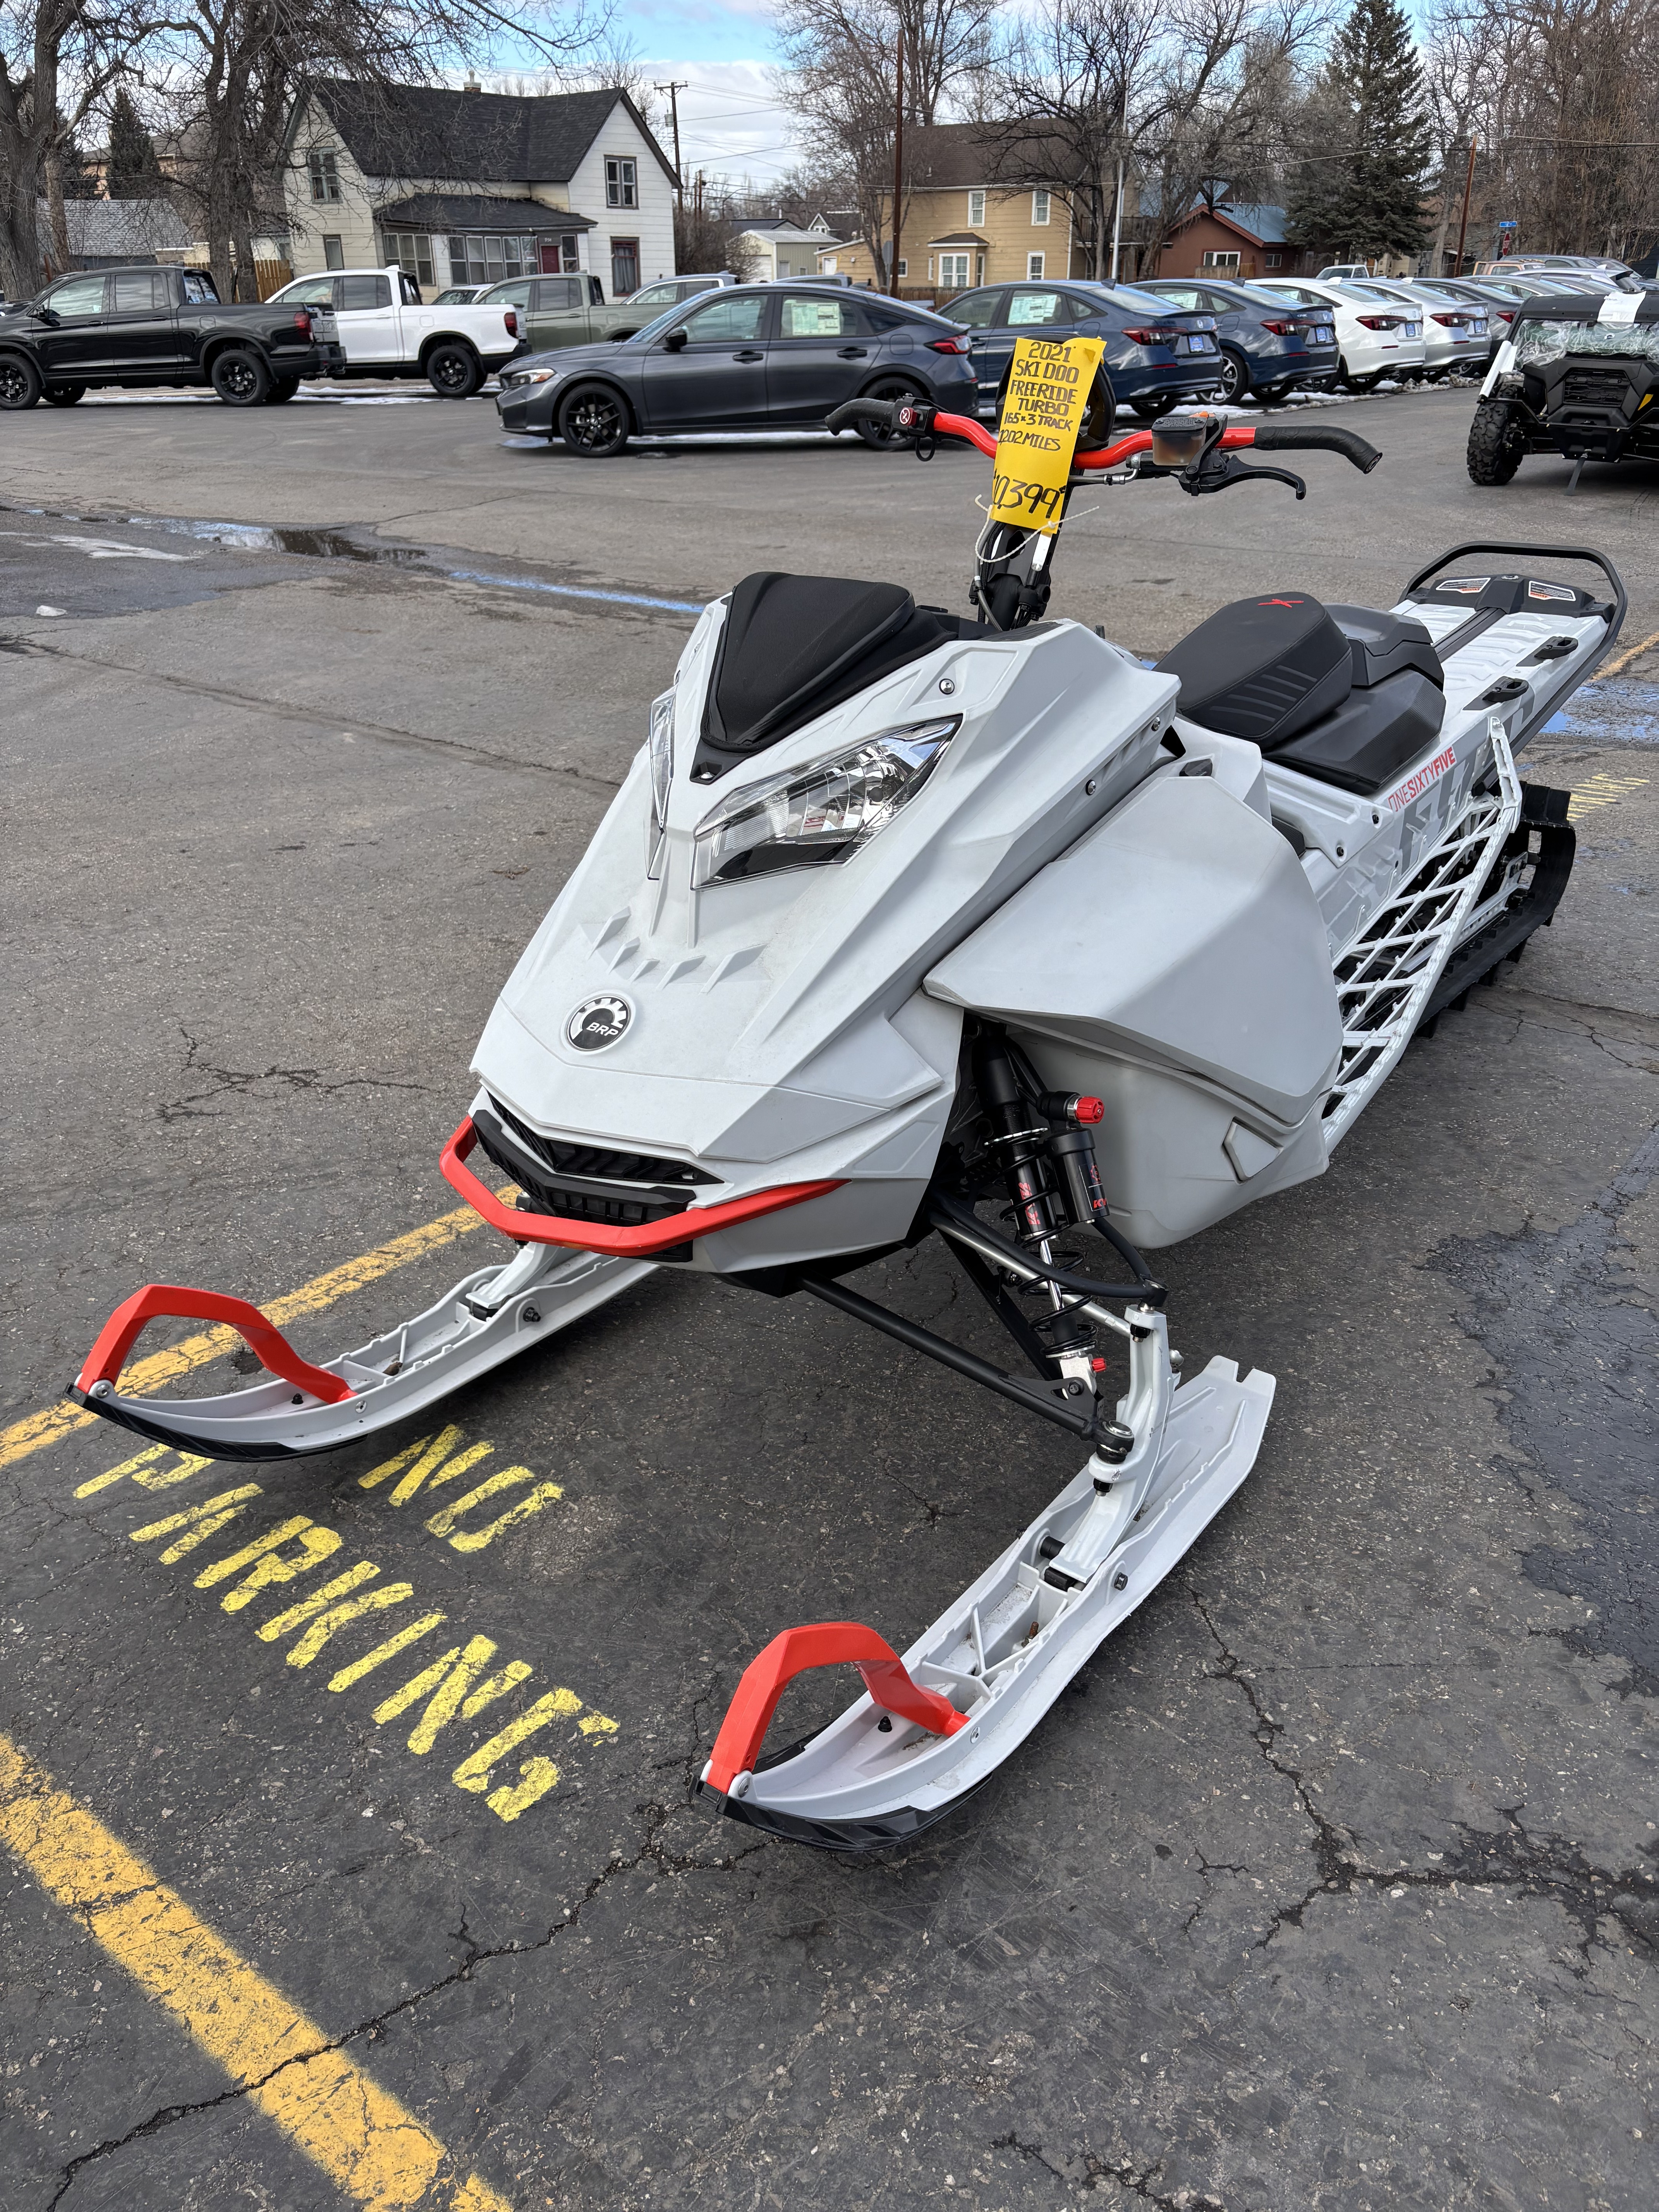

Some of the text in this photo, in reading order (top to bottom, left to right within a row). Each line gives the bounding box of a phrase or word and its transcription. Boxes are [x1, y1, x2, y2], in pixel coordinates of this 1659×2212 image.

[1028, 341, 1072, 362] 2021
[1015, 359, 1080, 384] SKI DOO
[1010, 380, 1078, 404] FREERIDE
[1018, 398, 1069, 417] TURBO
[1038, 414, 1073, 432] TRACK
[1021, 432, 1061, 451] MILES
[1388, 746, 1456, 812] ONESIXTYFIVE
[586, 1022, 619, 1036] BRP
[358, 1424, 565, 1553] NO
[74, 1444, 620, 1822] PARKING
